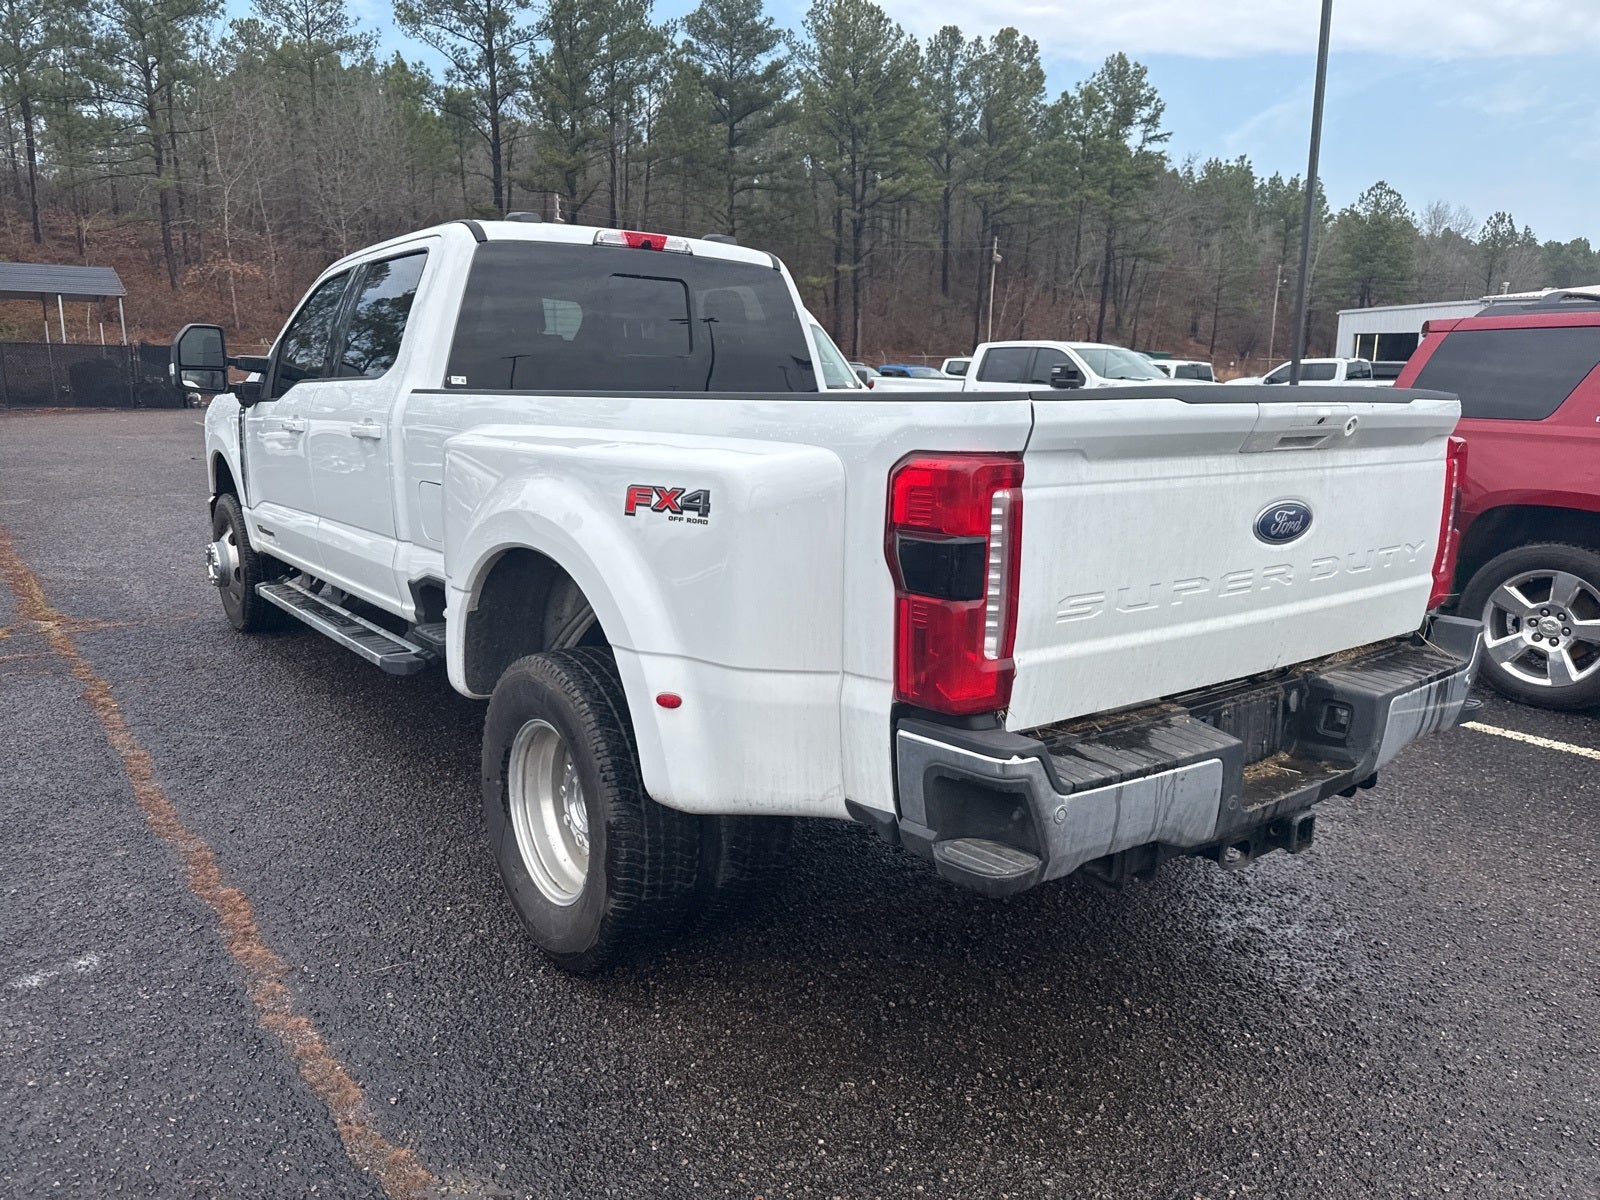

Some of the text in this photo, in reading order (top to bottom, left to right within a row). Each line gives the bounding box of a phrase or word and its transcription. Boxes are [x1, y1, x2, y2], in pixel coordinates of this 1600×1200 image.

[624, 484, 711, 518] FX4
[686, 517, 709, 525] ROAD
[1270, 510, 1304, 536] Ford
[1056, 539, 1425, 624] SUPER DUTY
